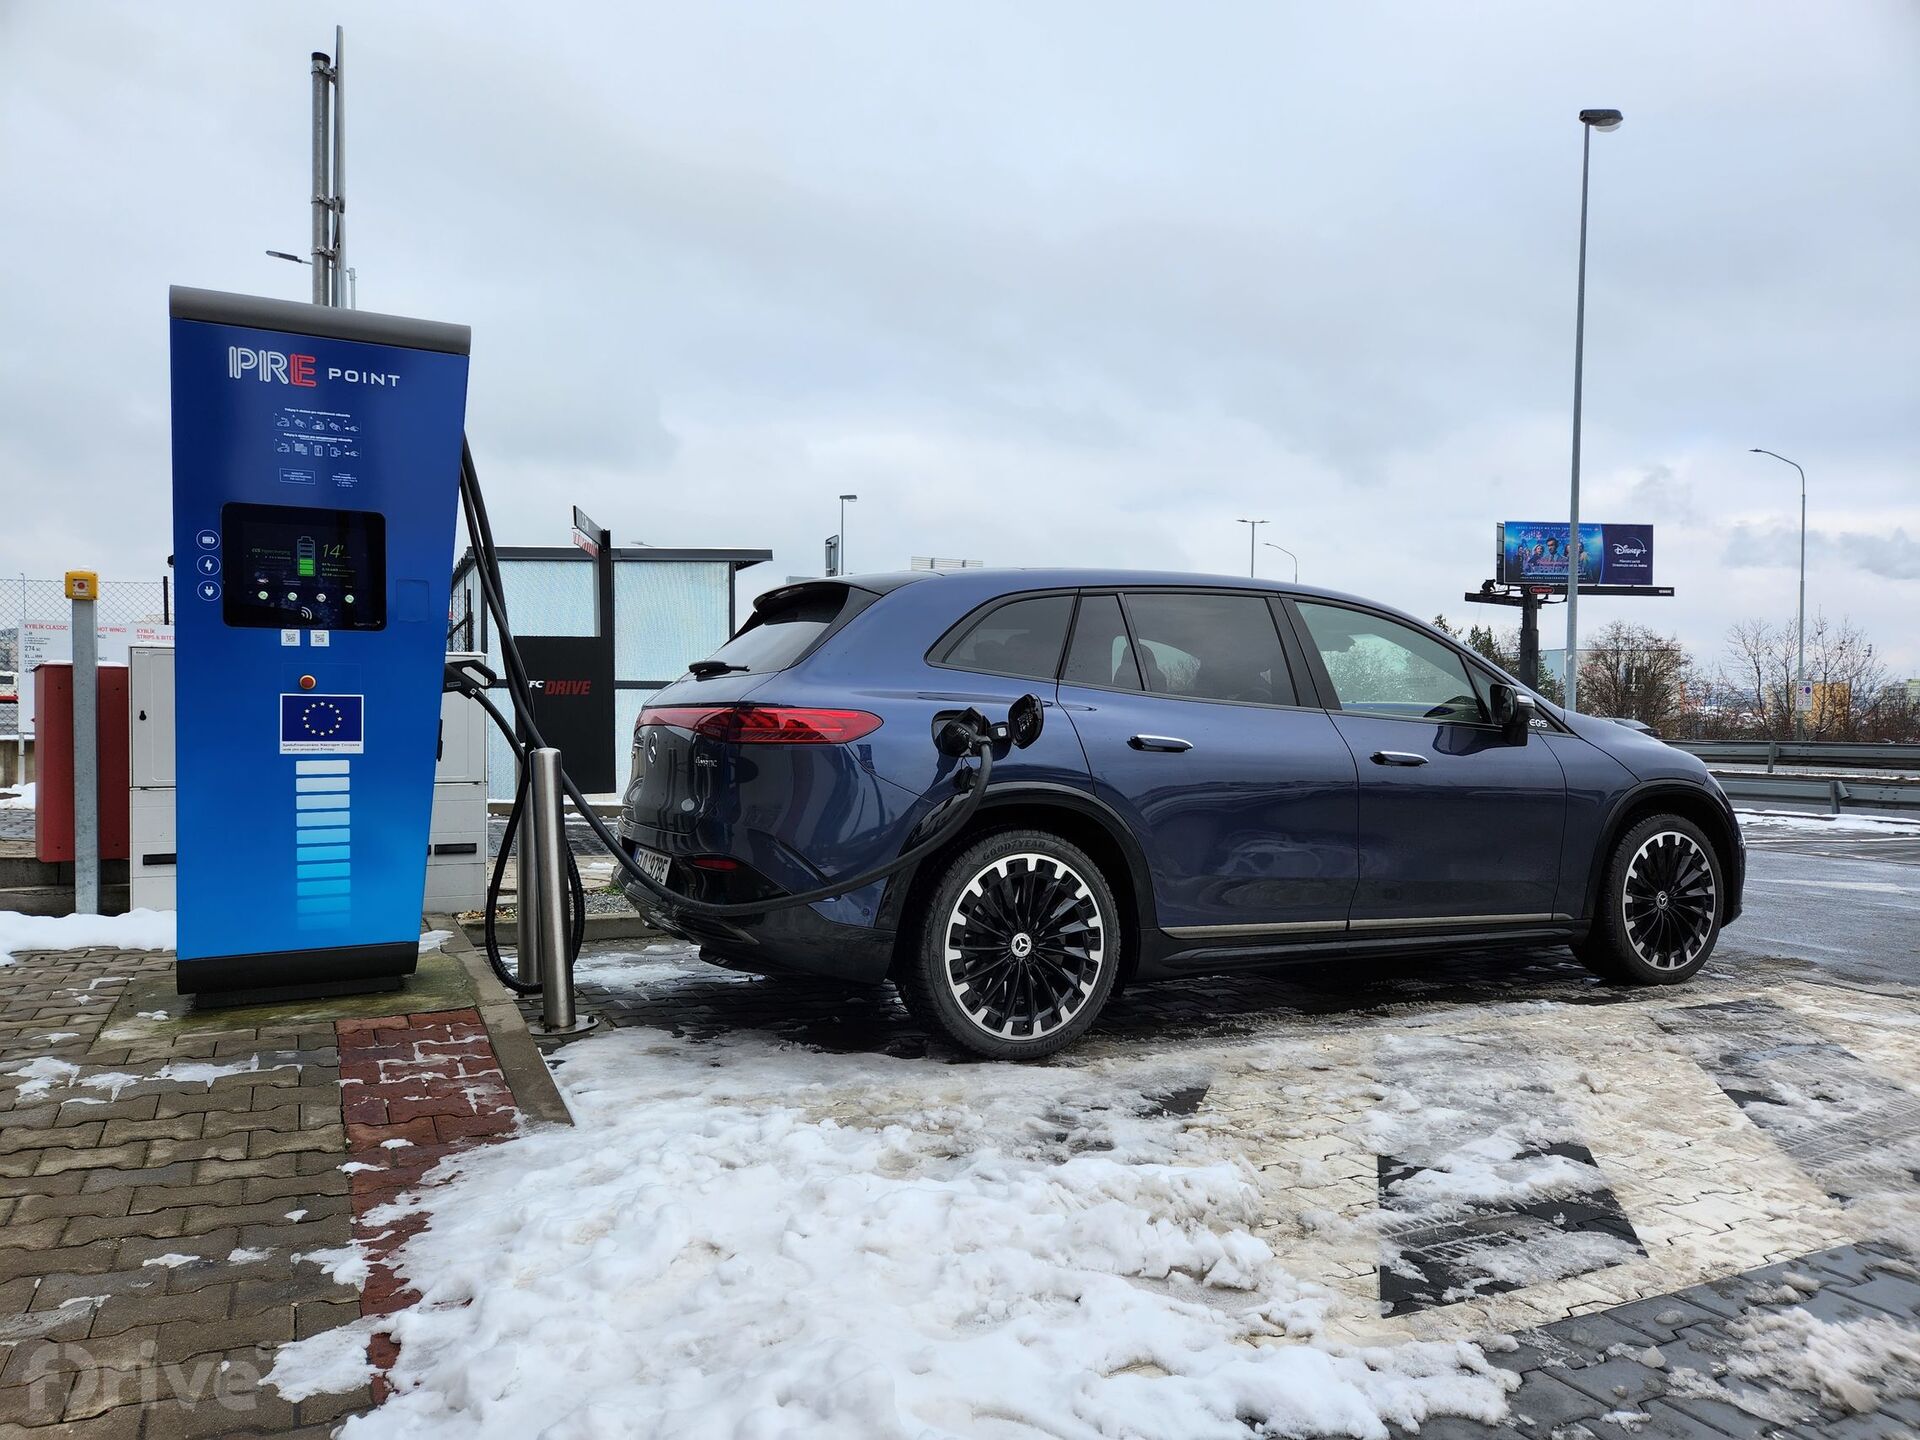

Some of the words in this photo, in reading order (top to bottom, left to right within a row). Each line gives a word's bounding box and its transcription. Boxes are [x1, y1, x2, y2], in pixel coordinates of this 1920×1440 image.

[228, 346, 317, 387] PRE
[328, 367, 401, 387] POINT
[527, 680, 545, 689] FC
[544, 680, 592, 695] DRIVE
[1529, 718, 1548, 728] EQS
